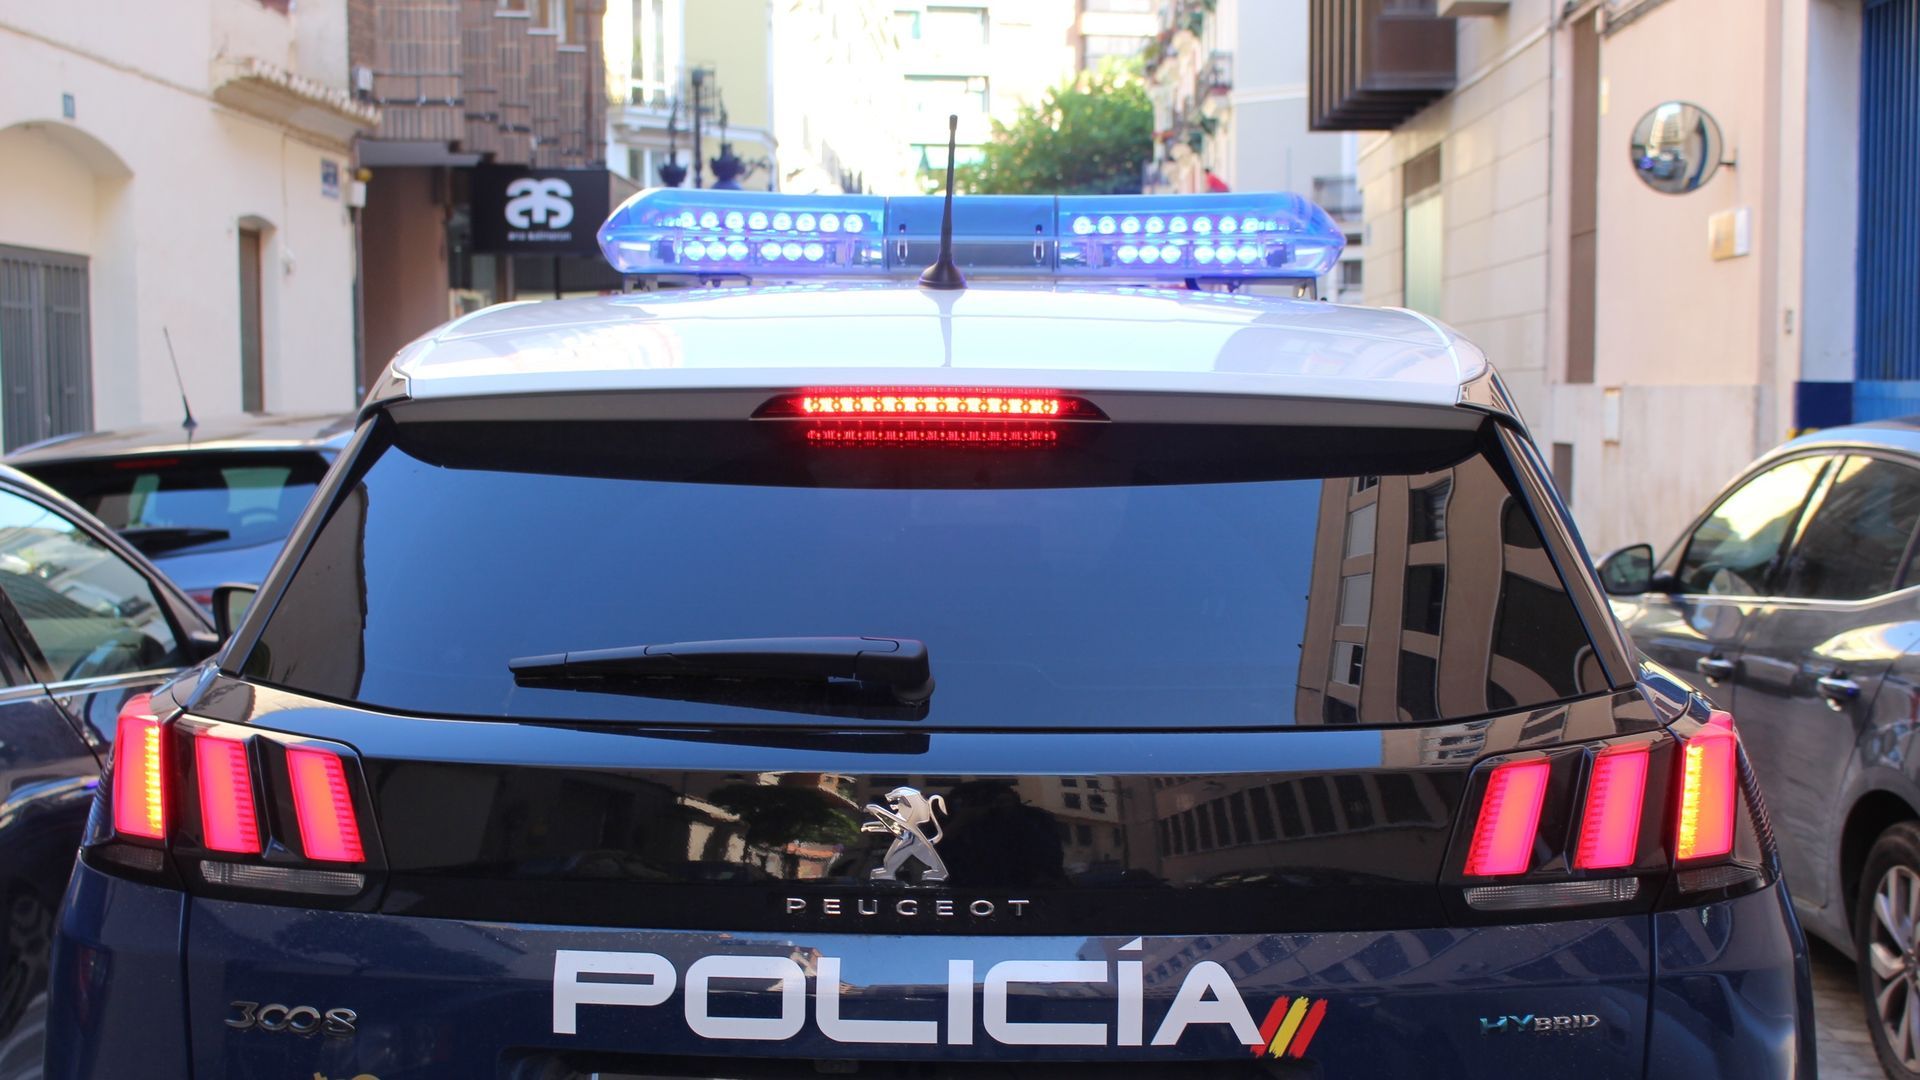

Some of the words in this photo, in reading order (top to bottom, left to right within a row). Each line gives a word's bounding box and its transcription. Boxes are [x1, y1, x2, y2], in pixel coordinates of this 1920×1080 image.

[786, 898, 1030, 916] PEUGEOT
[553, 936, 1266, 1046] POLICÍA
[224, 1001, 358, 1037] 3008
[1480, 1014, 1601, 1034] HYBRID
